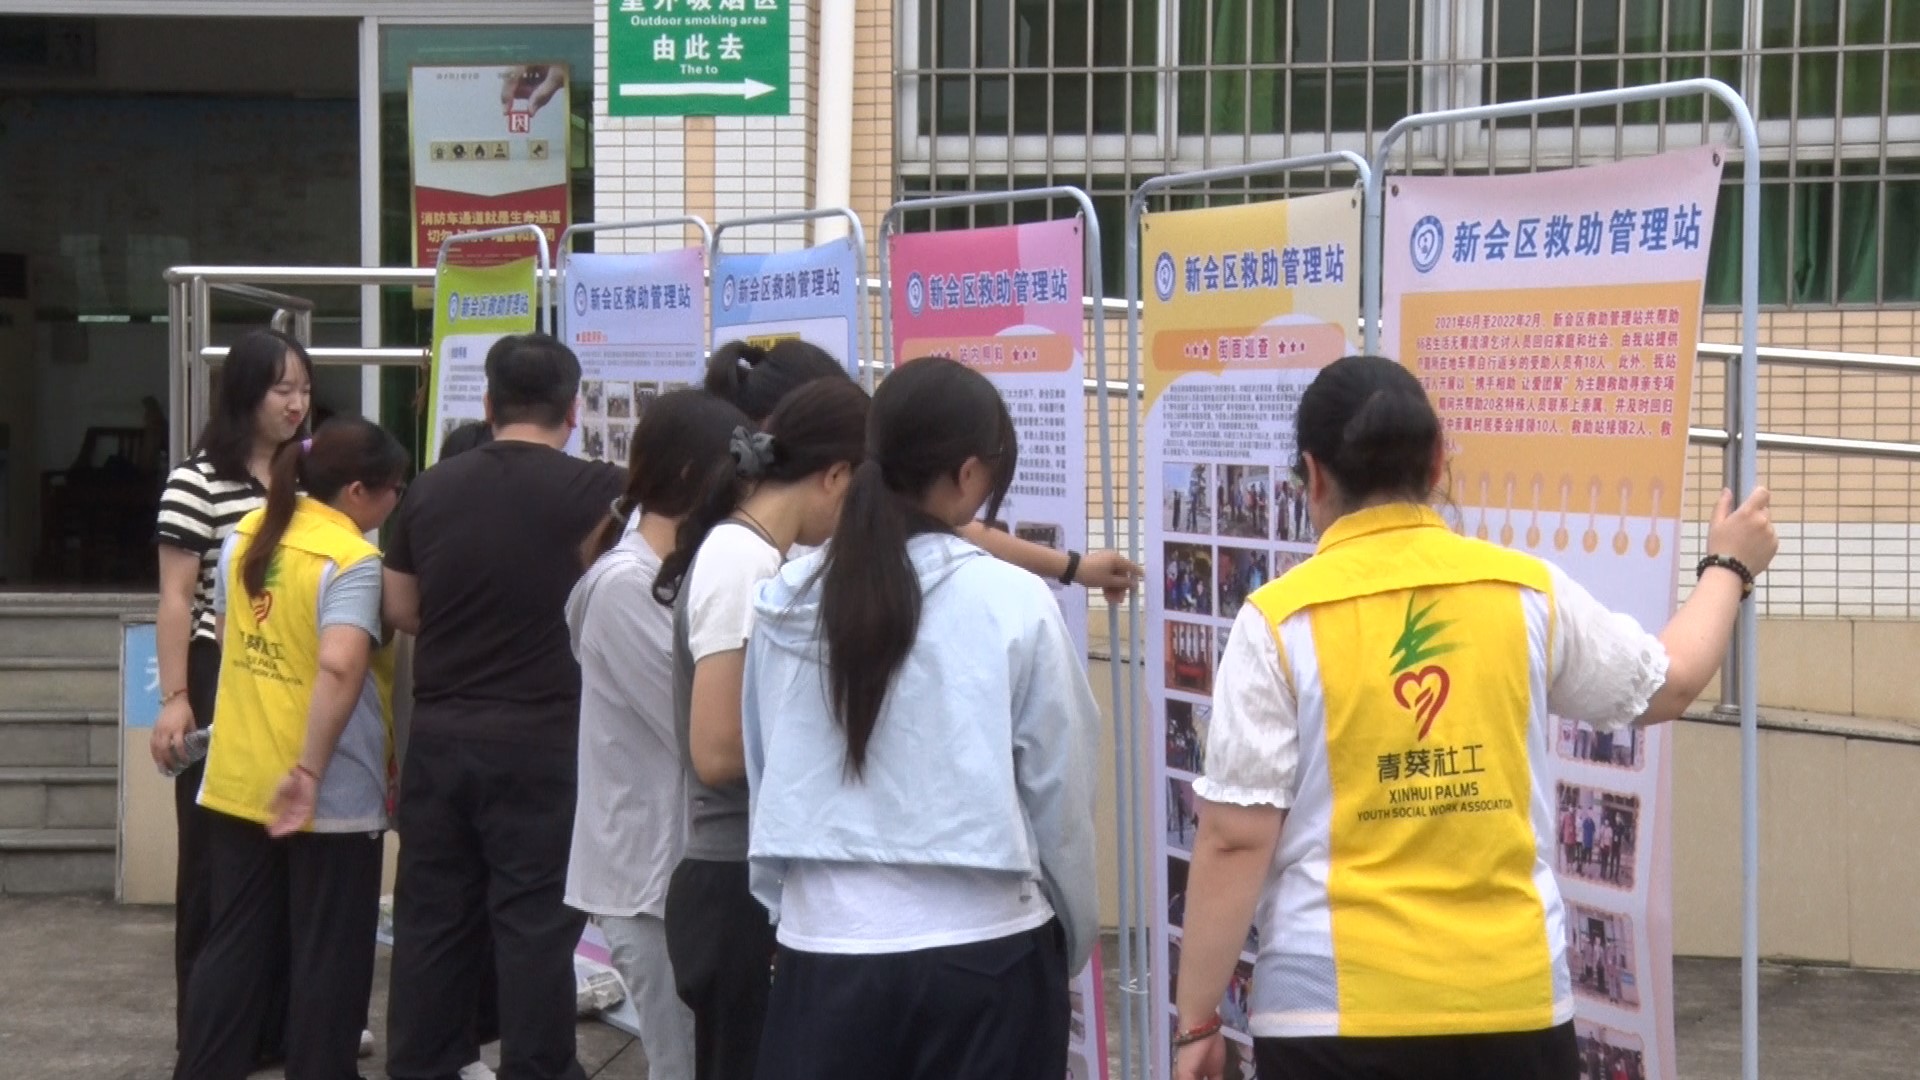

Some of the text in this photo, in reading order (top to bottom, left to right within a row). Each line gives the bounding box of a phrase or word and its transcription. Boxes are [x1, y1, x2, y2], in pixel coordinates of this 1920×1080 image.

[631, 15, 767, 27] Outdoor smoking area
[653, 33, 744, 61] 由此去
[680, 64, 718, 75] The to
[421, 210, 561, 226] 消防车通道就是生命通道
[1452, 202, 1702, 263] 新会区救助管理站
[1185, 243, 1345, 292] 新会区救助管理站
[591, 283, 691, 311] 新会区救助管理站
[738, 267, 841, 304] 新会区救助管理站
[929, 268, 1068, 308] 新会区救助管理站
[1377, 744, 1486, 783] 青葵社工
[1389, 782, 1479, 804] XINHUI PALMS
[1357, 808, 1391, 822] YOUTH
[1392, 806, 1427, 819] SOCIAL
[1429, 803, 1458, 817] WORK
